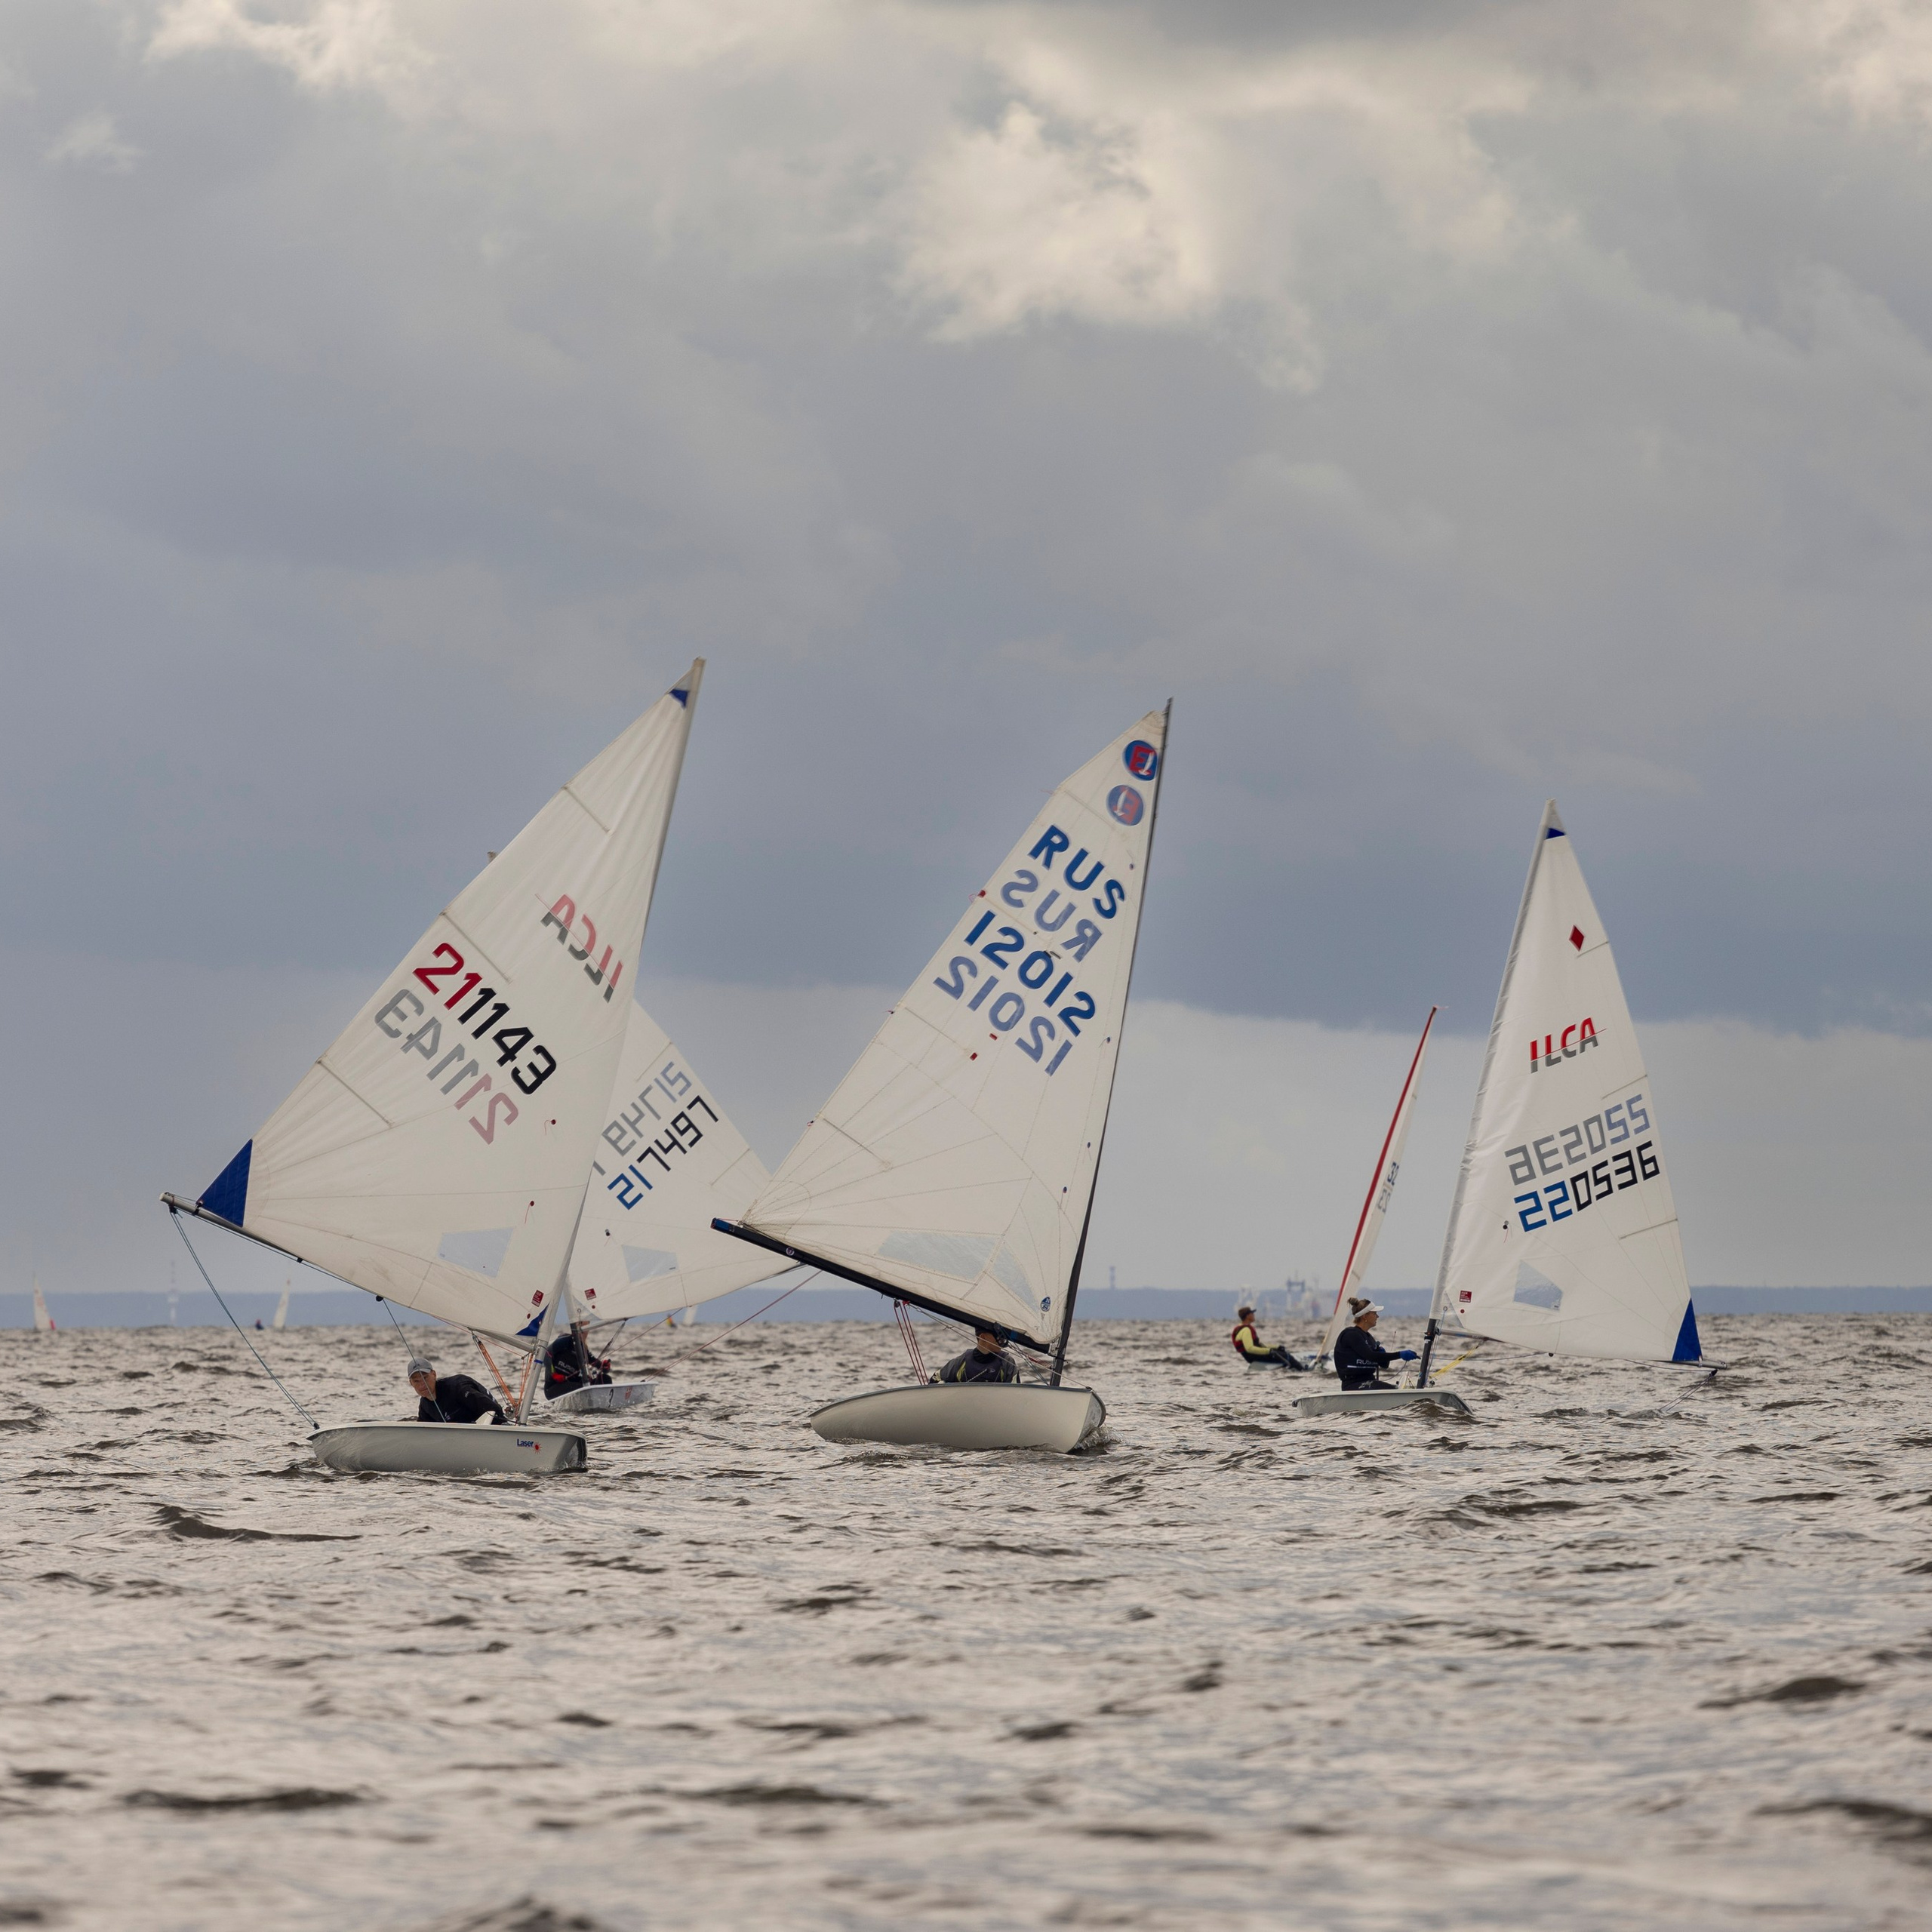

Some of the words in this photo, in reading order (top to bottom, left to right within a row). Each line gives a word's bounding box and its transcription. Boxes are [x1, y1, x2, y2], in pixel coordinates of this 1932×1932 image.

[1027, 825, 1125, 919] RUS
[412, 943, 557, 1094] 211143
[964, 910, 1096, 1037] 12012
[1530, 1017, 1598, 1074] ILCA
[607, 1095, 718, 1211] 217497
[1514, 1140, 1660, 1232] 220536
[517, 1438, 534, 1447] Laser
